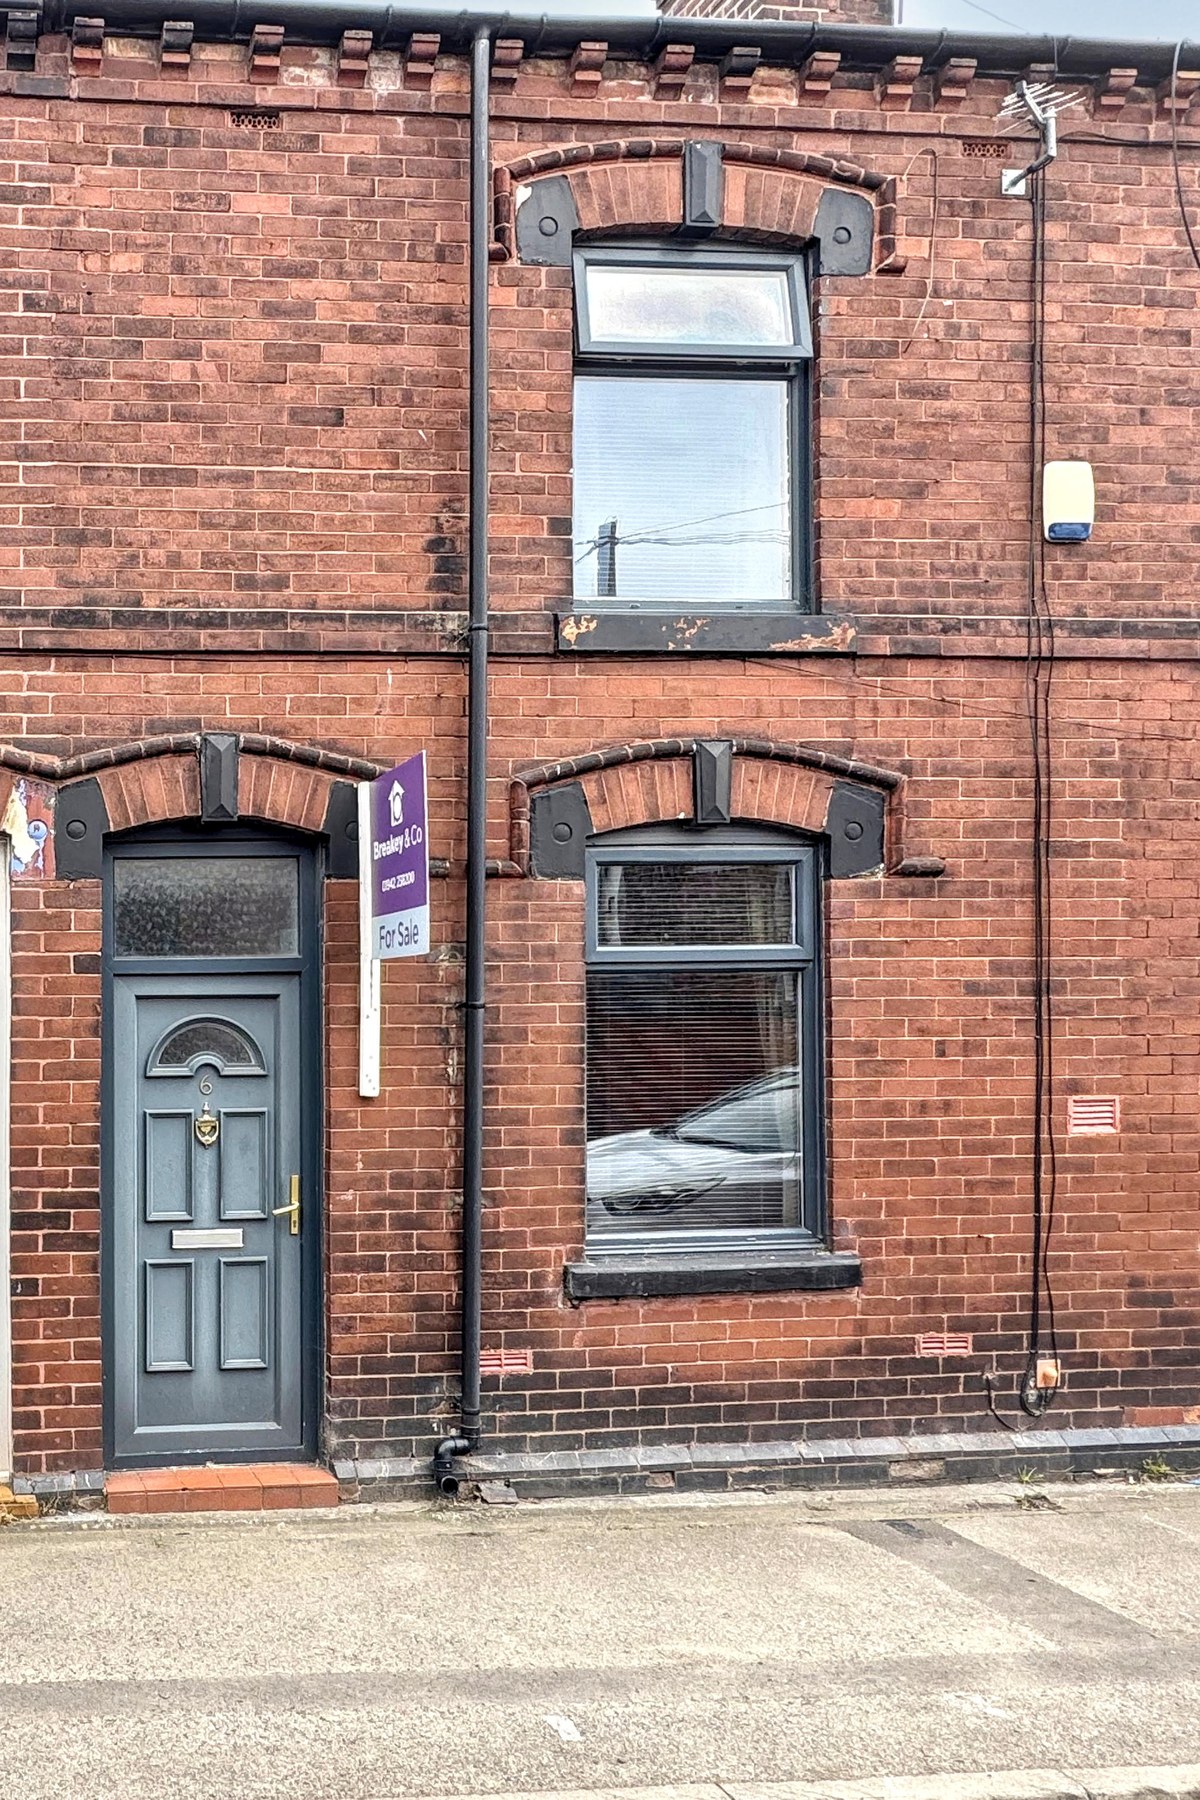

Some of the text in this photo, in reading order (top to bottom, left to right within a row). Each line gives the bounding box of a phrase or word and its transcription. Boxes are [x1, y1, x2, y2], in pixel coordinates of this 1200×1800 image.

[373, 824, 423, 860] Breakey & Co
[379, 919, 419, 950] For Sale
[200, 1074, 213, 1095] 6
